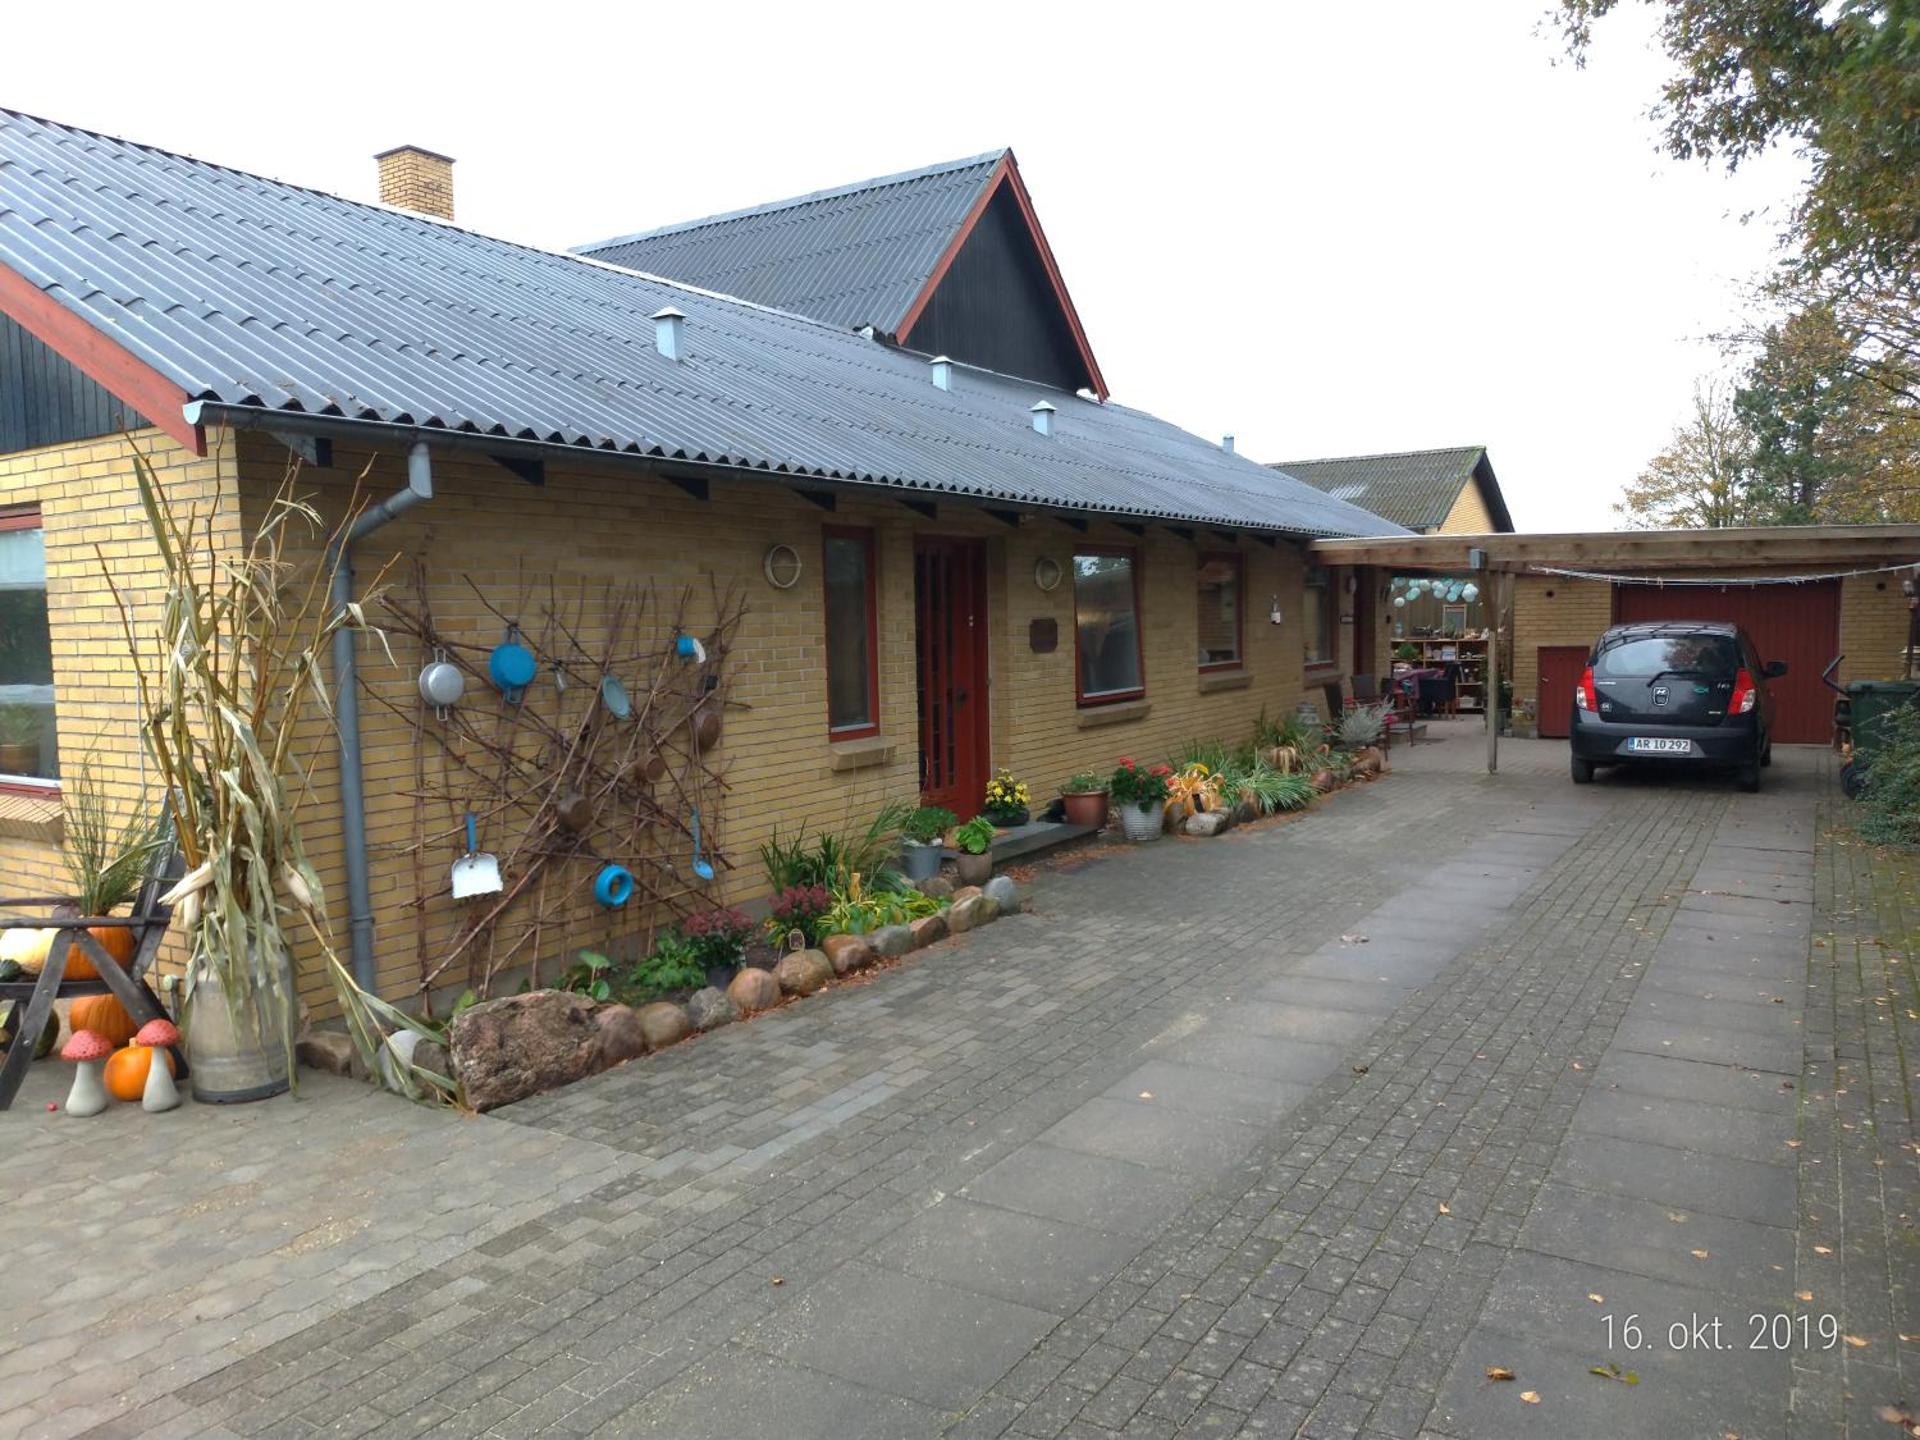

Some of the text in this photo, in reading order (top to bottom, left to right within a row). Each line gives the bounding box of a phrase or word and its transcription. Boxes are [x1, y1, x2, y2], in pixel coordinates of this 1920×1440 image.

[1635, 739, 1689, 751] AR 10 292
